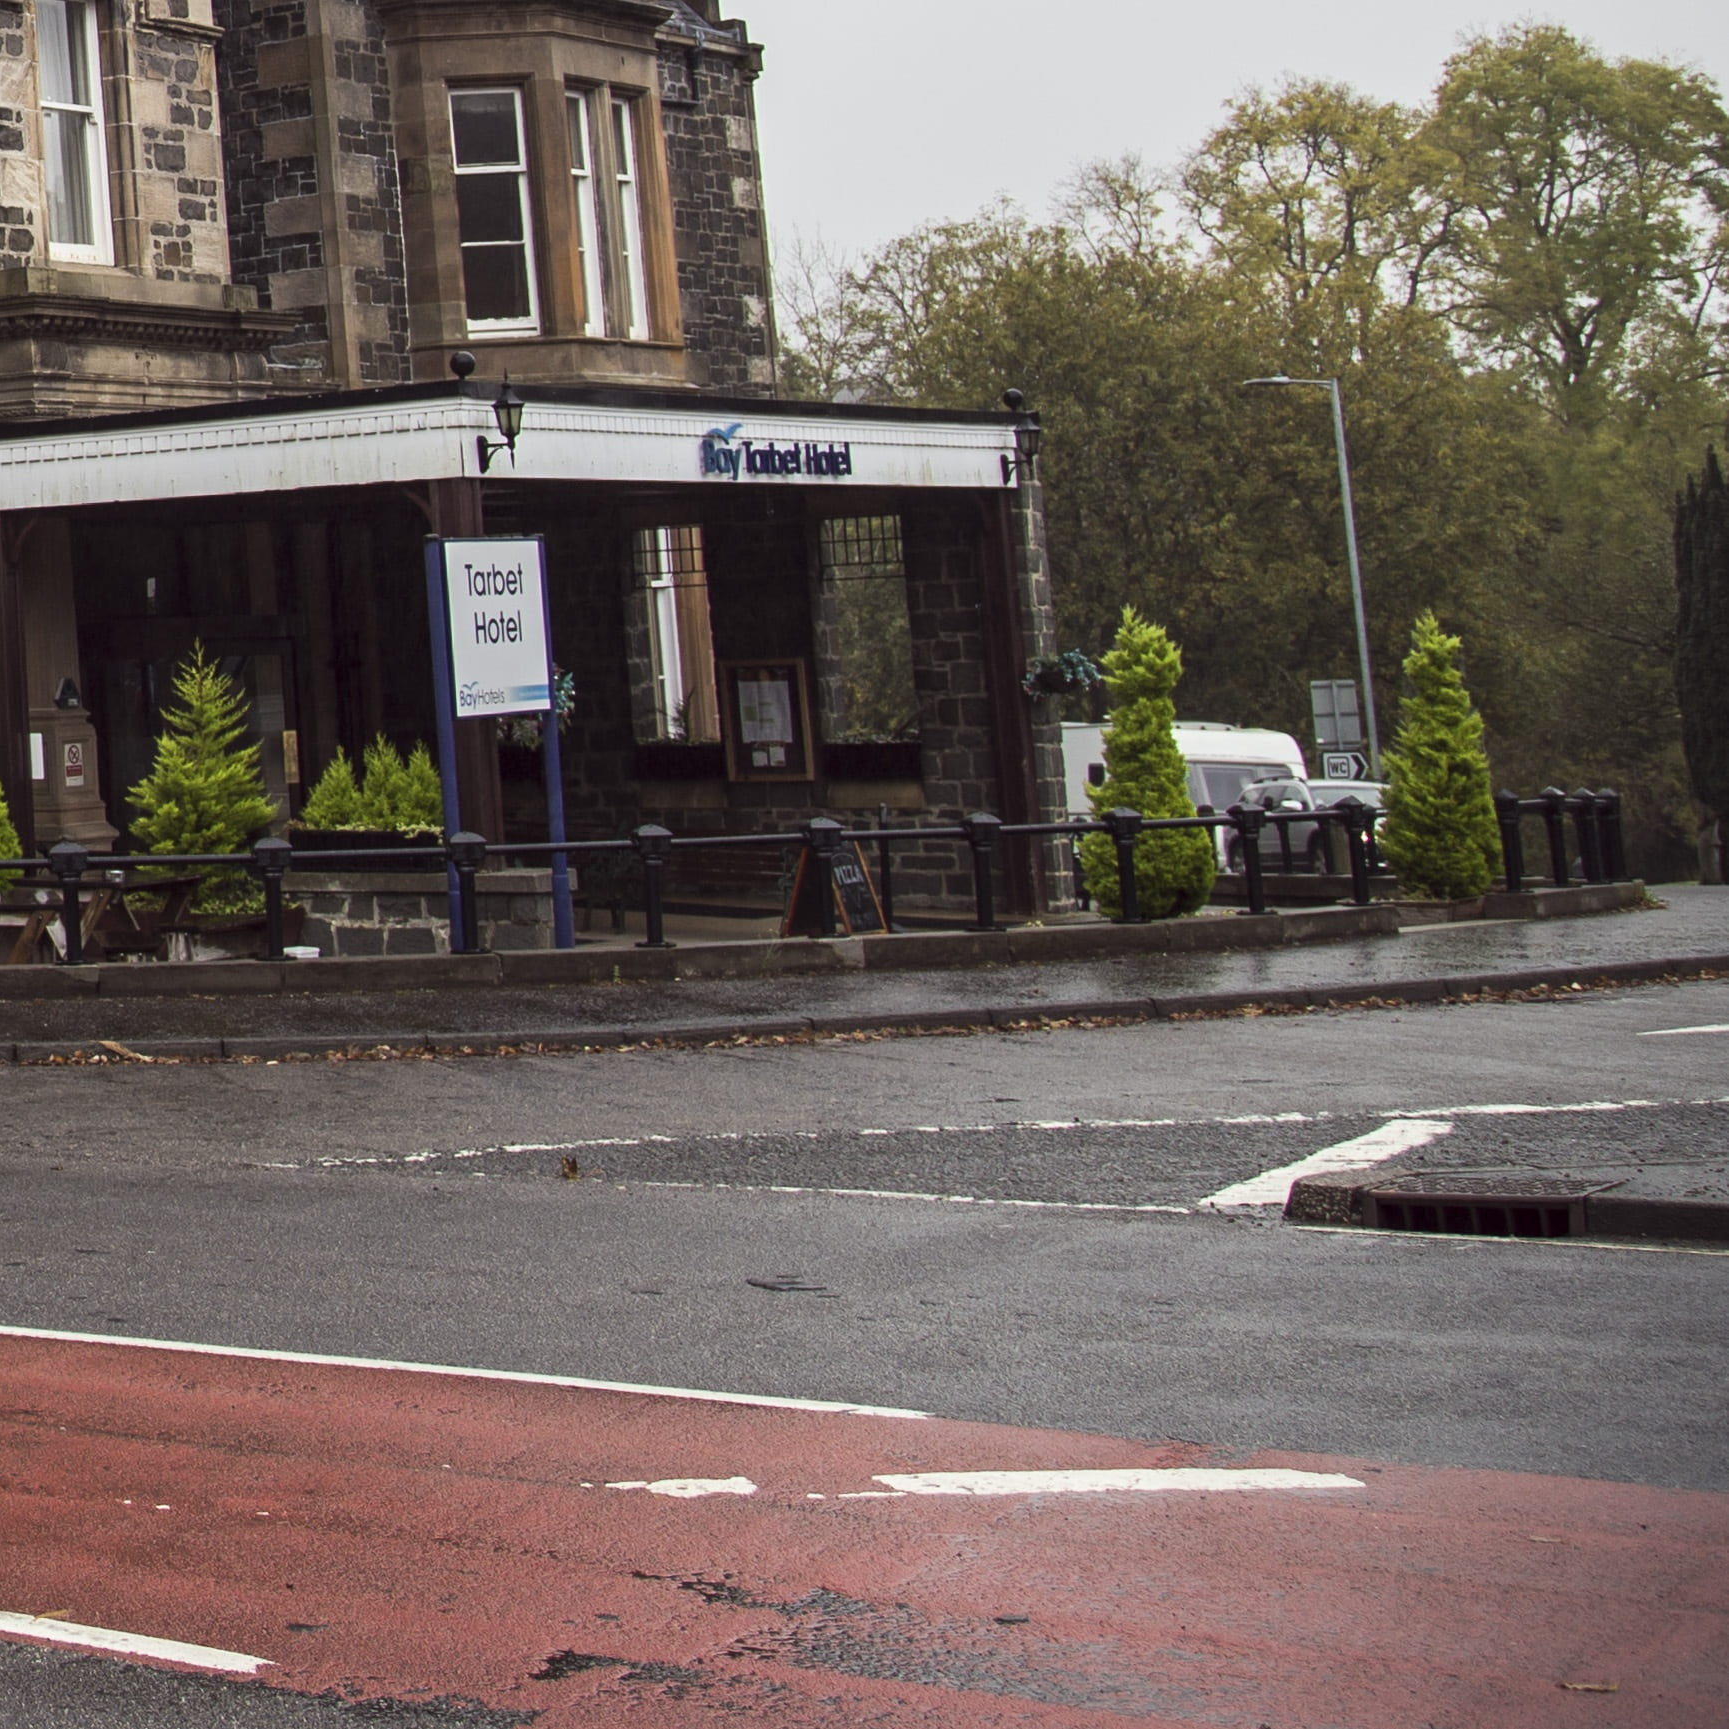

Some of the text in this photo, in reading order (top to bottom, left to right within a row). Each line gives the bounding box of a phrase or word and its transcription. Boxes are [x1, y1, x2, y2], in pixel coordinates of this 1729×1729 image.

[701, 438, 852, 481] Bay Tarbet Hotel
[464, 563, 523, 597] Tarbet
[474, 610, 523, 644] Hotel
[1329, 761, 1347, 774] WC
